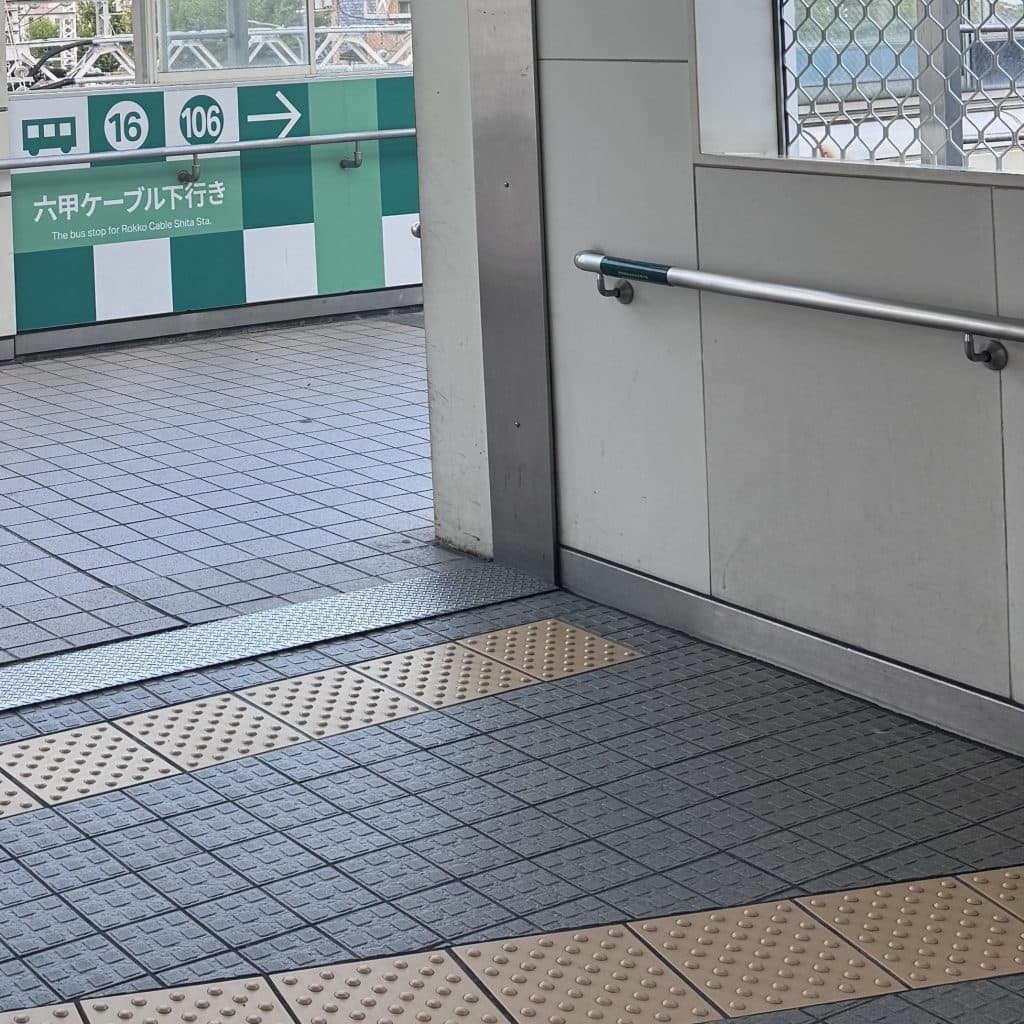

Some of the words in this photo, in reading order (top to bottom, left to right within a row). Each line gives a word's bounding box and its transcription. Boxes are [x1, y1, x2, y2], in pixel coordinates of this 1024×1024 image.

[108, 110, 142, 144] 16
[179, 104, 221, 140] 106
[33, 180, 226, 223] 六甲ケーブル下行き
[51, 230, 69, 241] The
[70, 229, 86, 239] bus
[87, 227, 107, 238] stop
[108, 225, 120, 236] for
[121, 223, 148, 234] Rokko
[148, 220, 173, 231] Cable
[174, 218, 195, 229] Shita
[196, 216, 212, 226] Sta.
